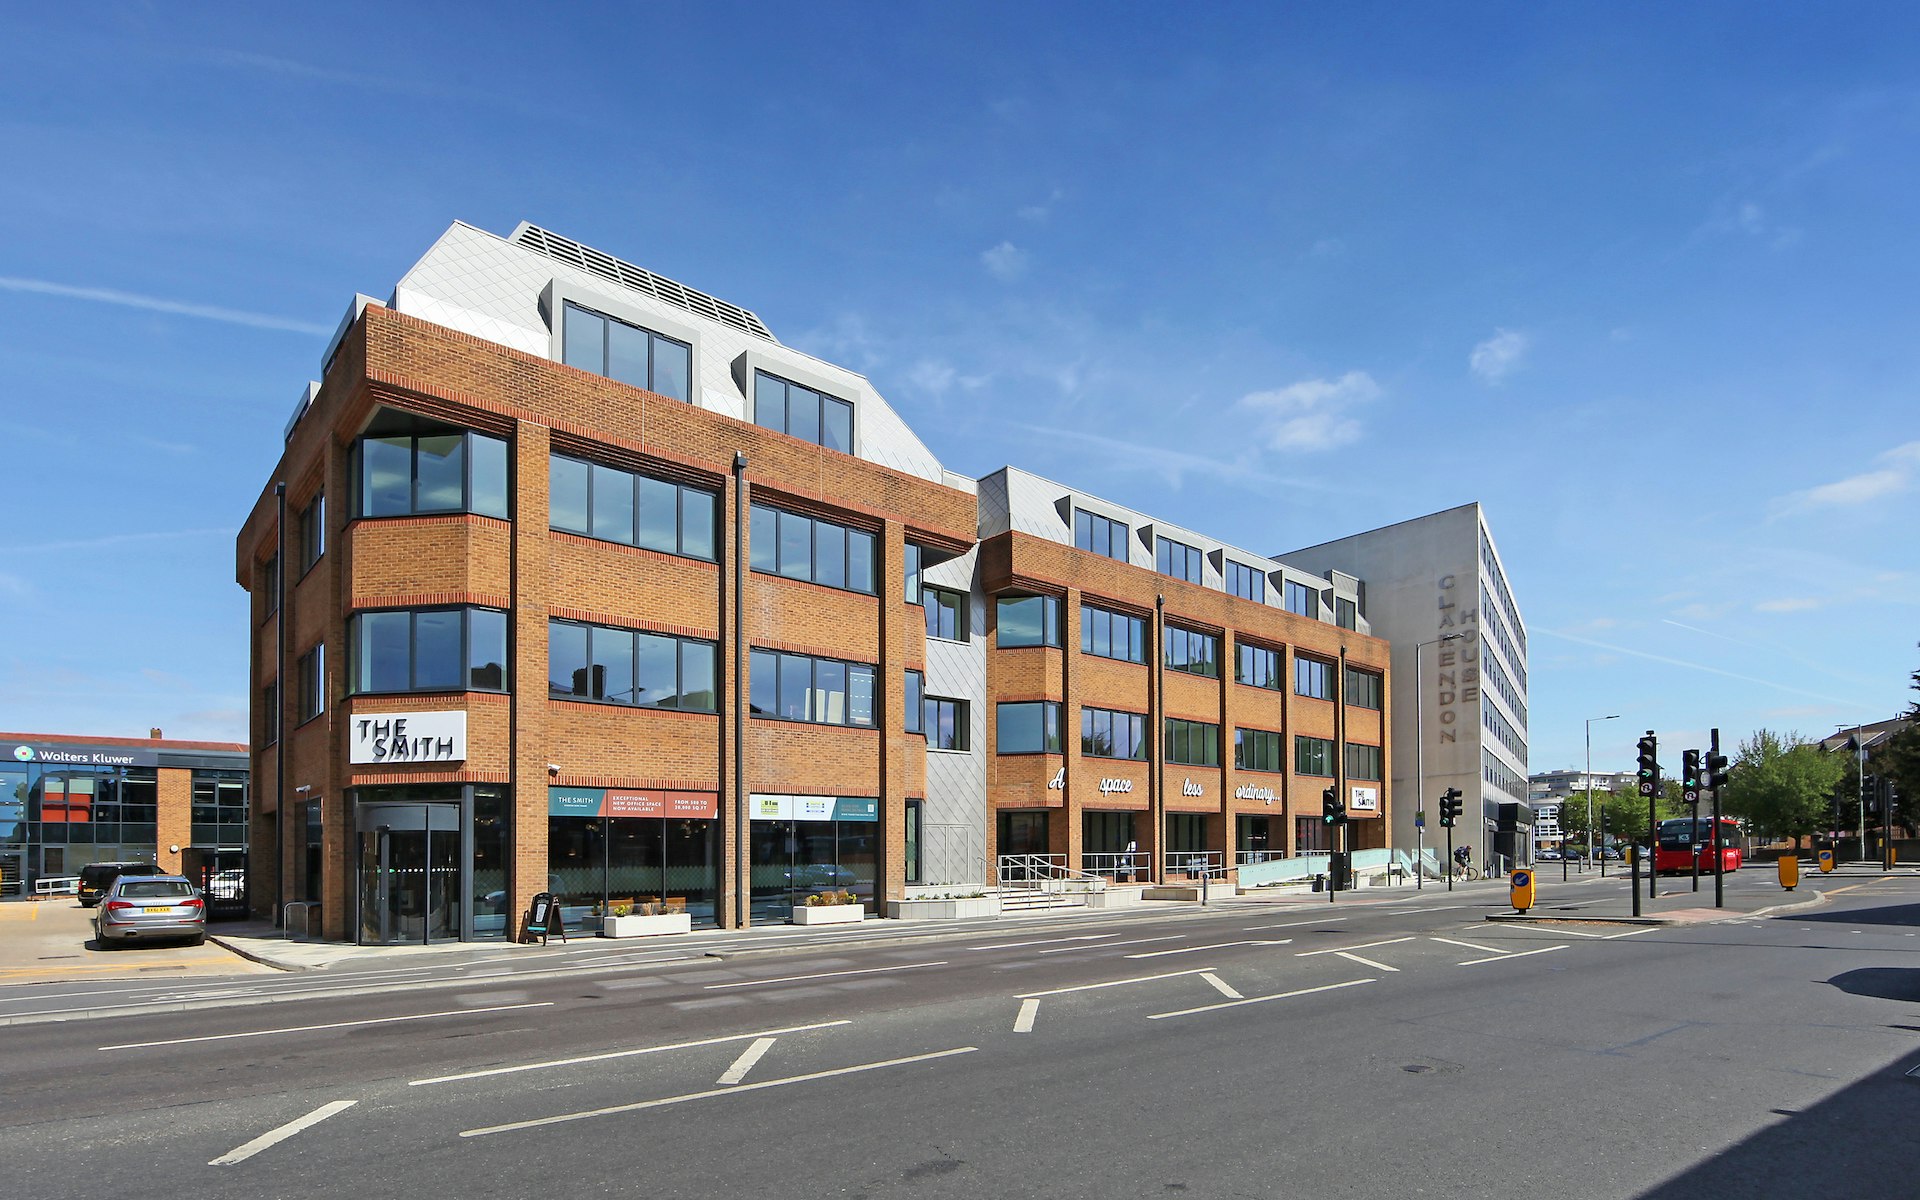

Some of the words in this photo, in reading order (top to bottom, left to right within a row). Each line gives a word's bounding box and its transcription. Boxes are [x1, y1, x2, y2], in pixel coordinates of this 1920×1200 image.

[1438, 574, 1456, 744] CLARENDON
[1460, 608, 1478, 703] HOUSE
[357, 719, 408, 742] THE
[39, 751, 88, 762] Wolters
[92, 753, 134, 763] Kluwer
[372, 736, 453, 762] SMITH
[1048, 767, 1065, 789] A
[1099, 778, 1132, 797] space
[1182, 777, 1203, 797] less
[1355, 790, 1365, 798] THE
[1678, 833, 1690, 841] K3
